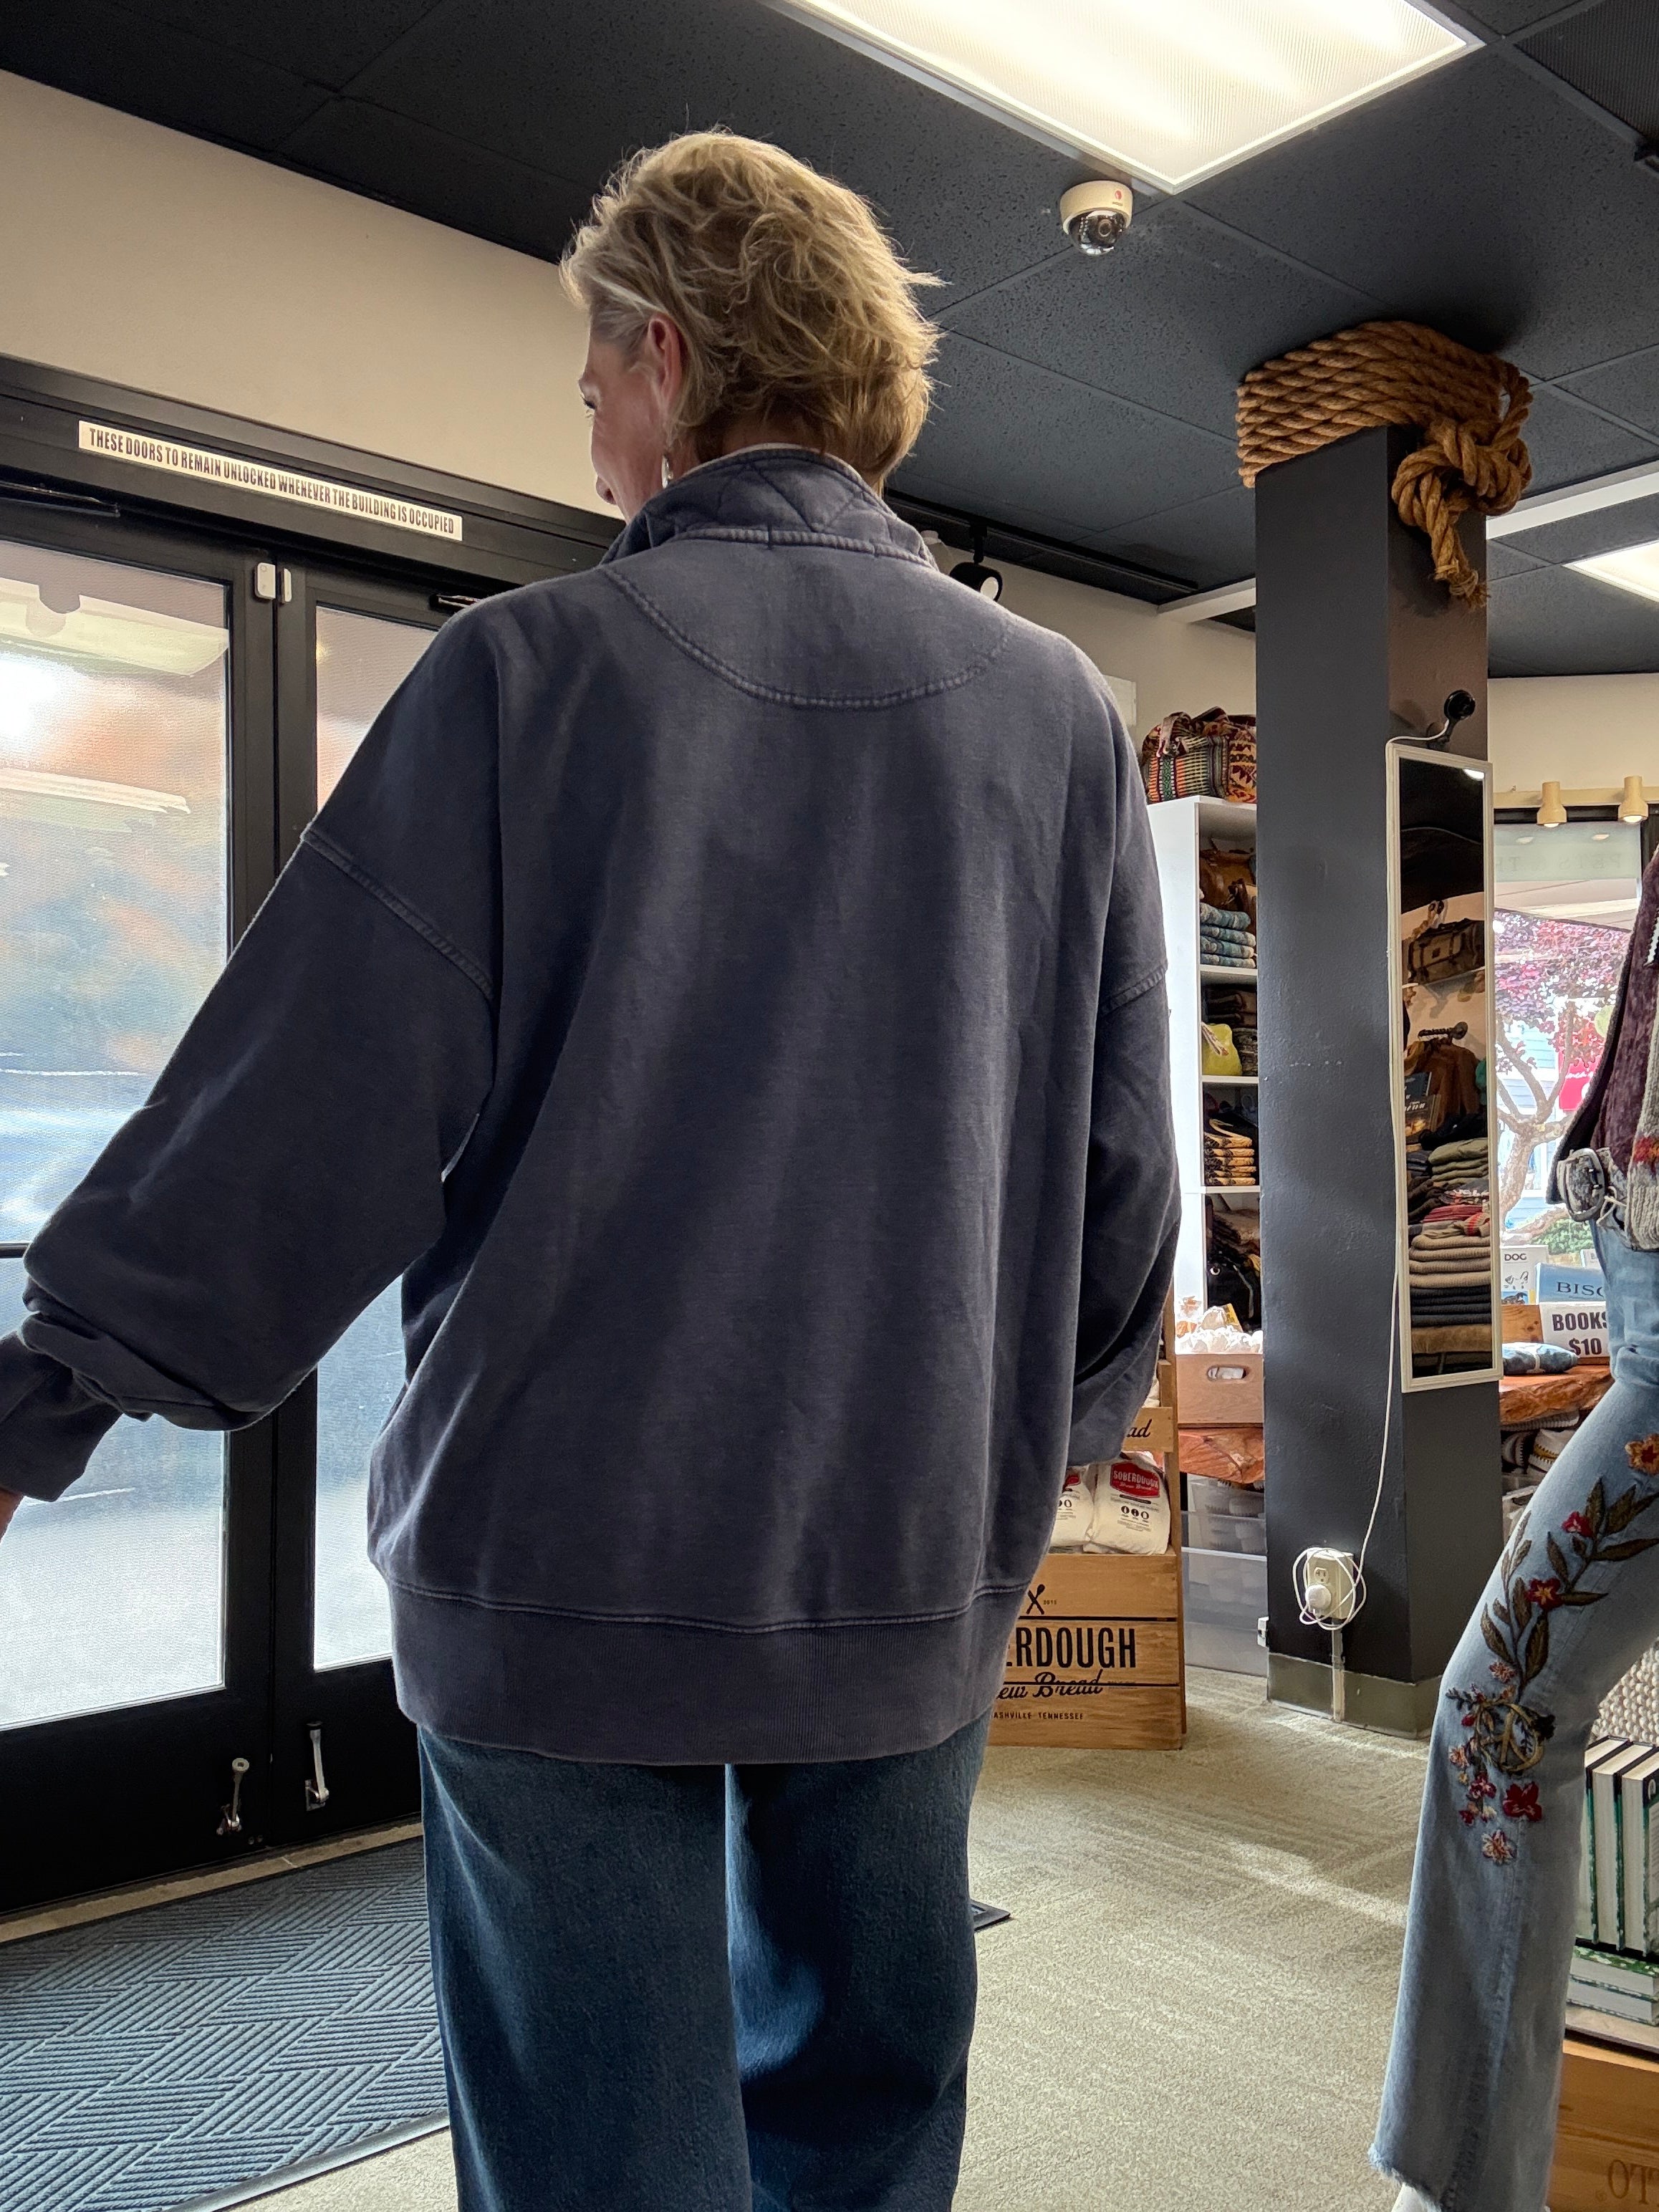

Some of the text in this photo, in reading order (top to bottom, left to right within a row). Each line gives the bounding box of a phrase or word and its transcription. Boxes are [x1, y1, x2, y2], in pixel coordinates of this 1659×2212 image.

[90, 428, 454, 534] THESE DOORS TO REMAIN UNLOCKED WHENEVER THE BUILDING IS OCCUPIED
[1504, 1253, 1527, 1261] DOG
[1568, 1337, 1602, 1356] $10
[1006, 1627, 1136, 1668] RDOUGH
[1032, 1668, 1104, 1698] Bread
